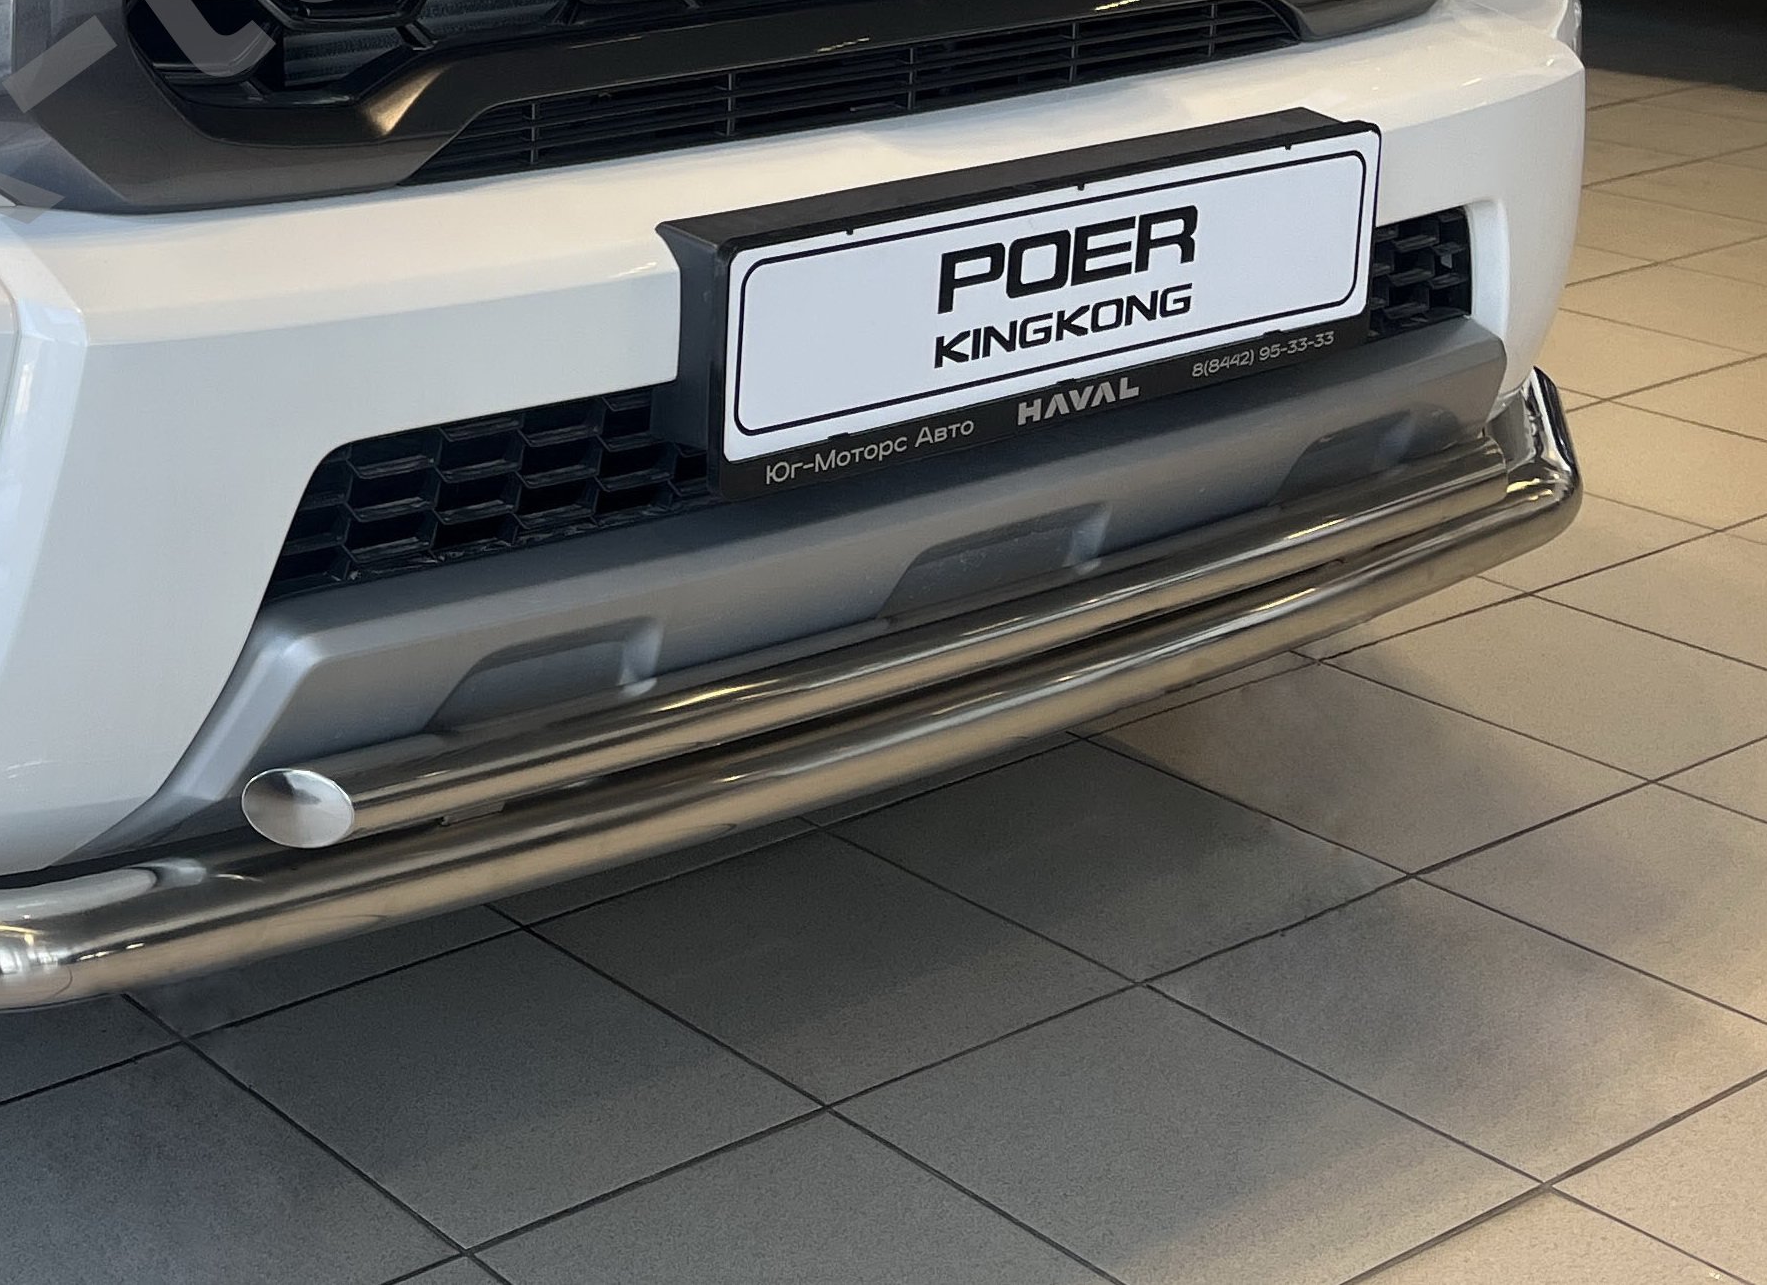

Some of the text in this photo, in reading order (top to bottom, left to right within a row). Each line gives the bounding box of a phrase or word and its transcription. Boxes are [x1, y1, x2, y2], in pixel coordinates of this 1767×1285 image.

[937, 204, 1199, 315] POER
[933, 282, 1194, 369] KINGKONG
[1191, 330, 1335, 378] 8(8442) 95-33-33
[1017, 377, 1140, 426] HAVAL
[765, 419, 975, 485] Юг-Моторс Авто
